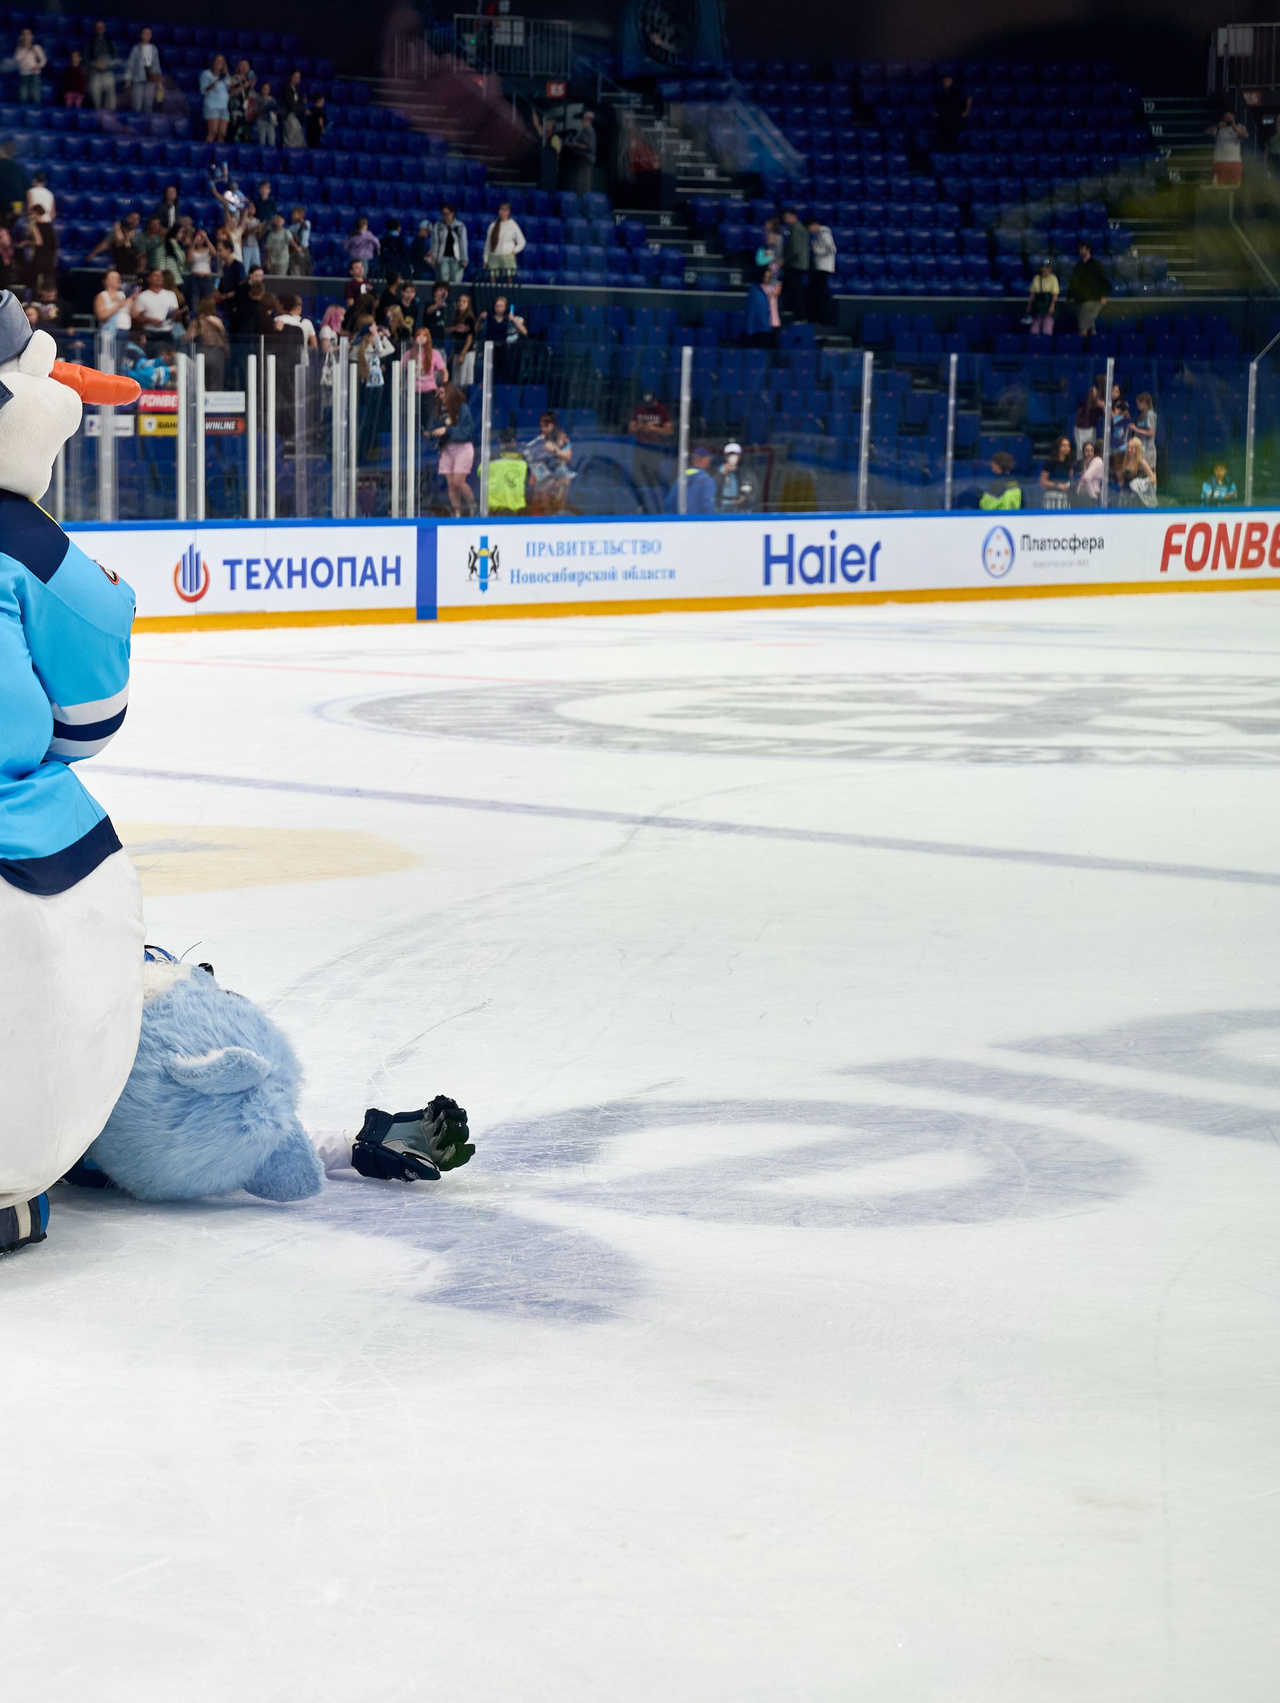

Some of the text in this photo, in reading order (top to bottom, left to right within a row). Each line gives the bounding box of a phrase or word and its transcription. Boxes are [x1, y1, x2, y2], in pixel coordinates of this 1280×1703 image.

[205, 420, 237, 431] WINLINE
[525, 539, 663, 558] ПРАВИТЕЛЬСТВО
[1020, 533, 1105, 555] Платосфера
[763, 529, 882, 586] Haier
[222, 555, 402, 591] ТЕХНОПАН
[509, 566, 677, 587] Новосибирской области
